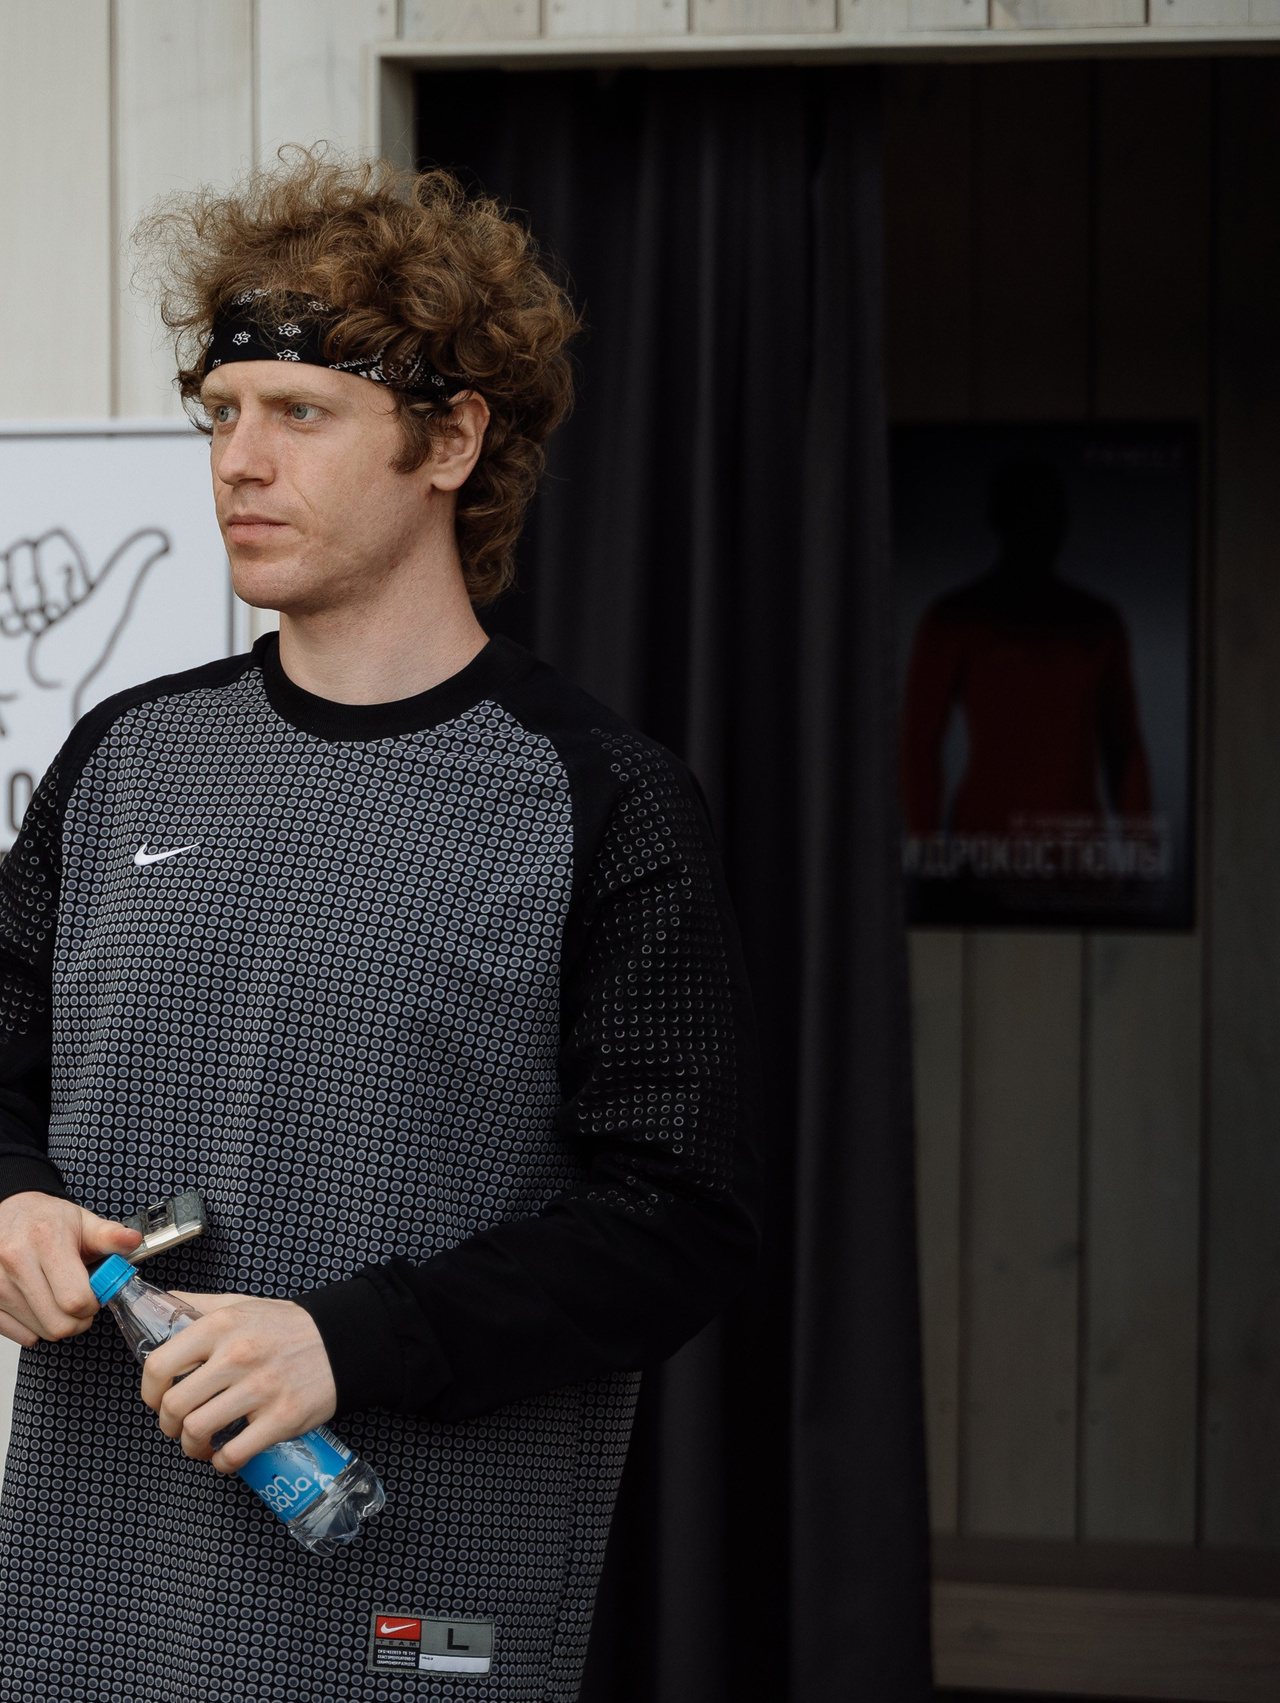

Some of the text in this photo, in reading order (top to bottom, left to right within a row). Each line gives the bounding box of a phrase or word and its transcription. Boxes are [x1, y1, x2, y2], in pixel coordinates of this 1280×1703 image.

[901, 836, 1170, 877] ИДРОКОСТЮМЫ
[256, 1475, 291, 1502] bon
[270, 1476, 313, 1512] aqua
[379, 1639, 416, 1647] TEAM
[447, 1627, 469, 1650] L
